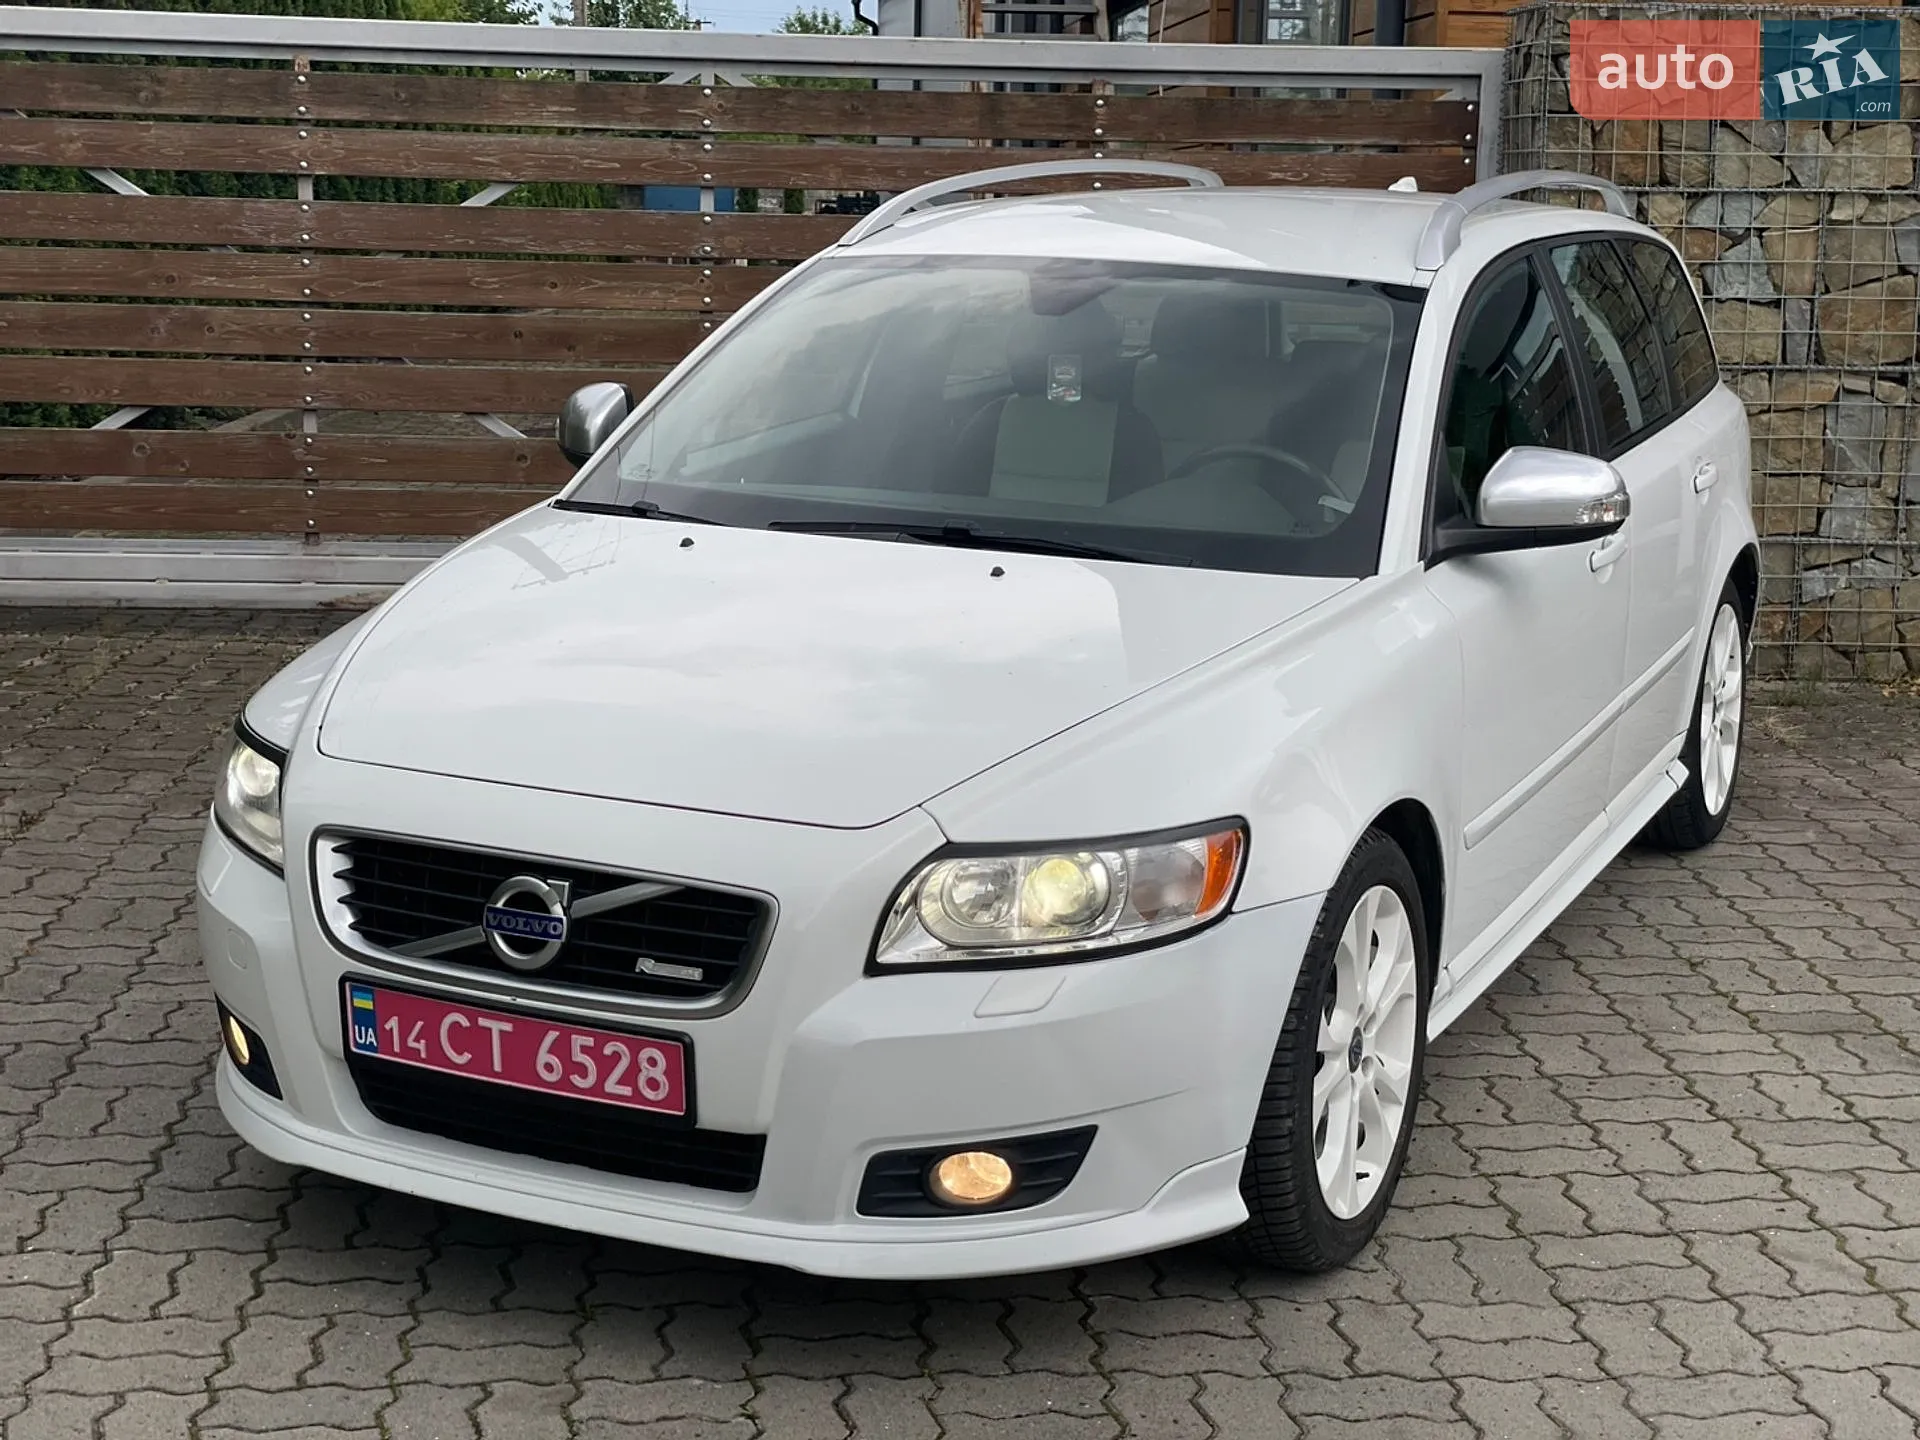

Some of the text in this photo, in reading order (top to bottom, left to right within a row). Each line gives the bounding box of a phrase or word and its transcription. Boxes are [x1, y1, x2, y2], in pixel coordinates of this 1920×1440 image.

[486, 911, 563, 936] VOLVO
[354, 1024, 377, 1047] UA
[384, 1012, 670, 1101] 14 CT 6528
